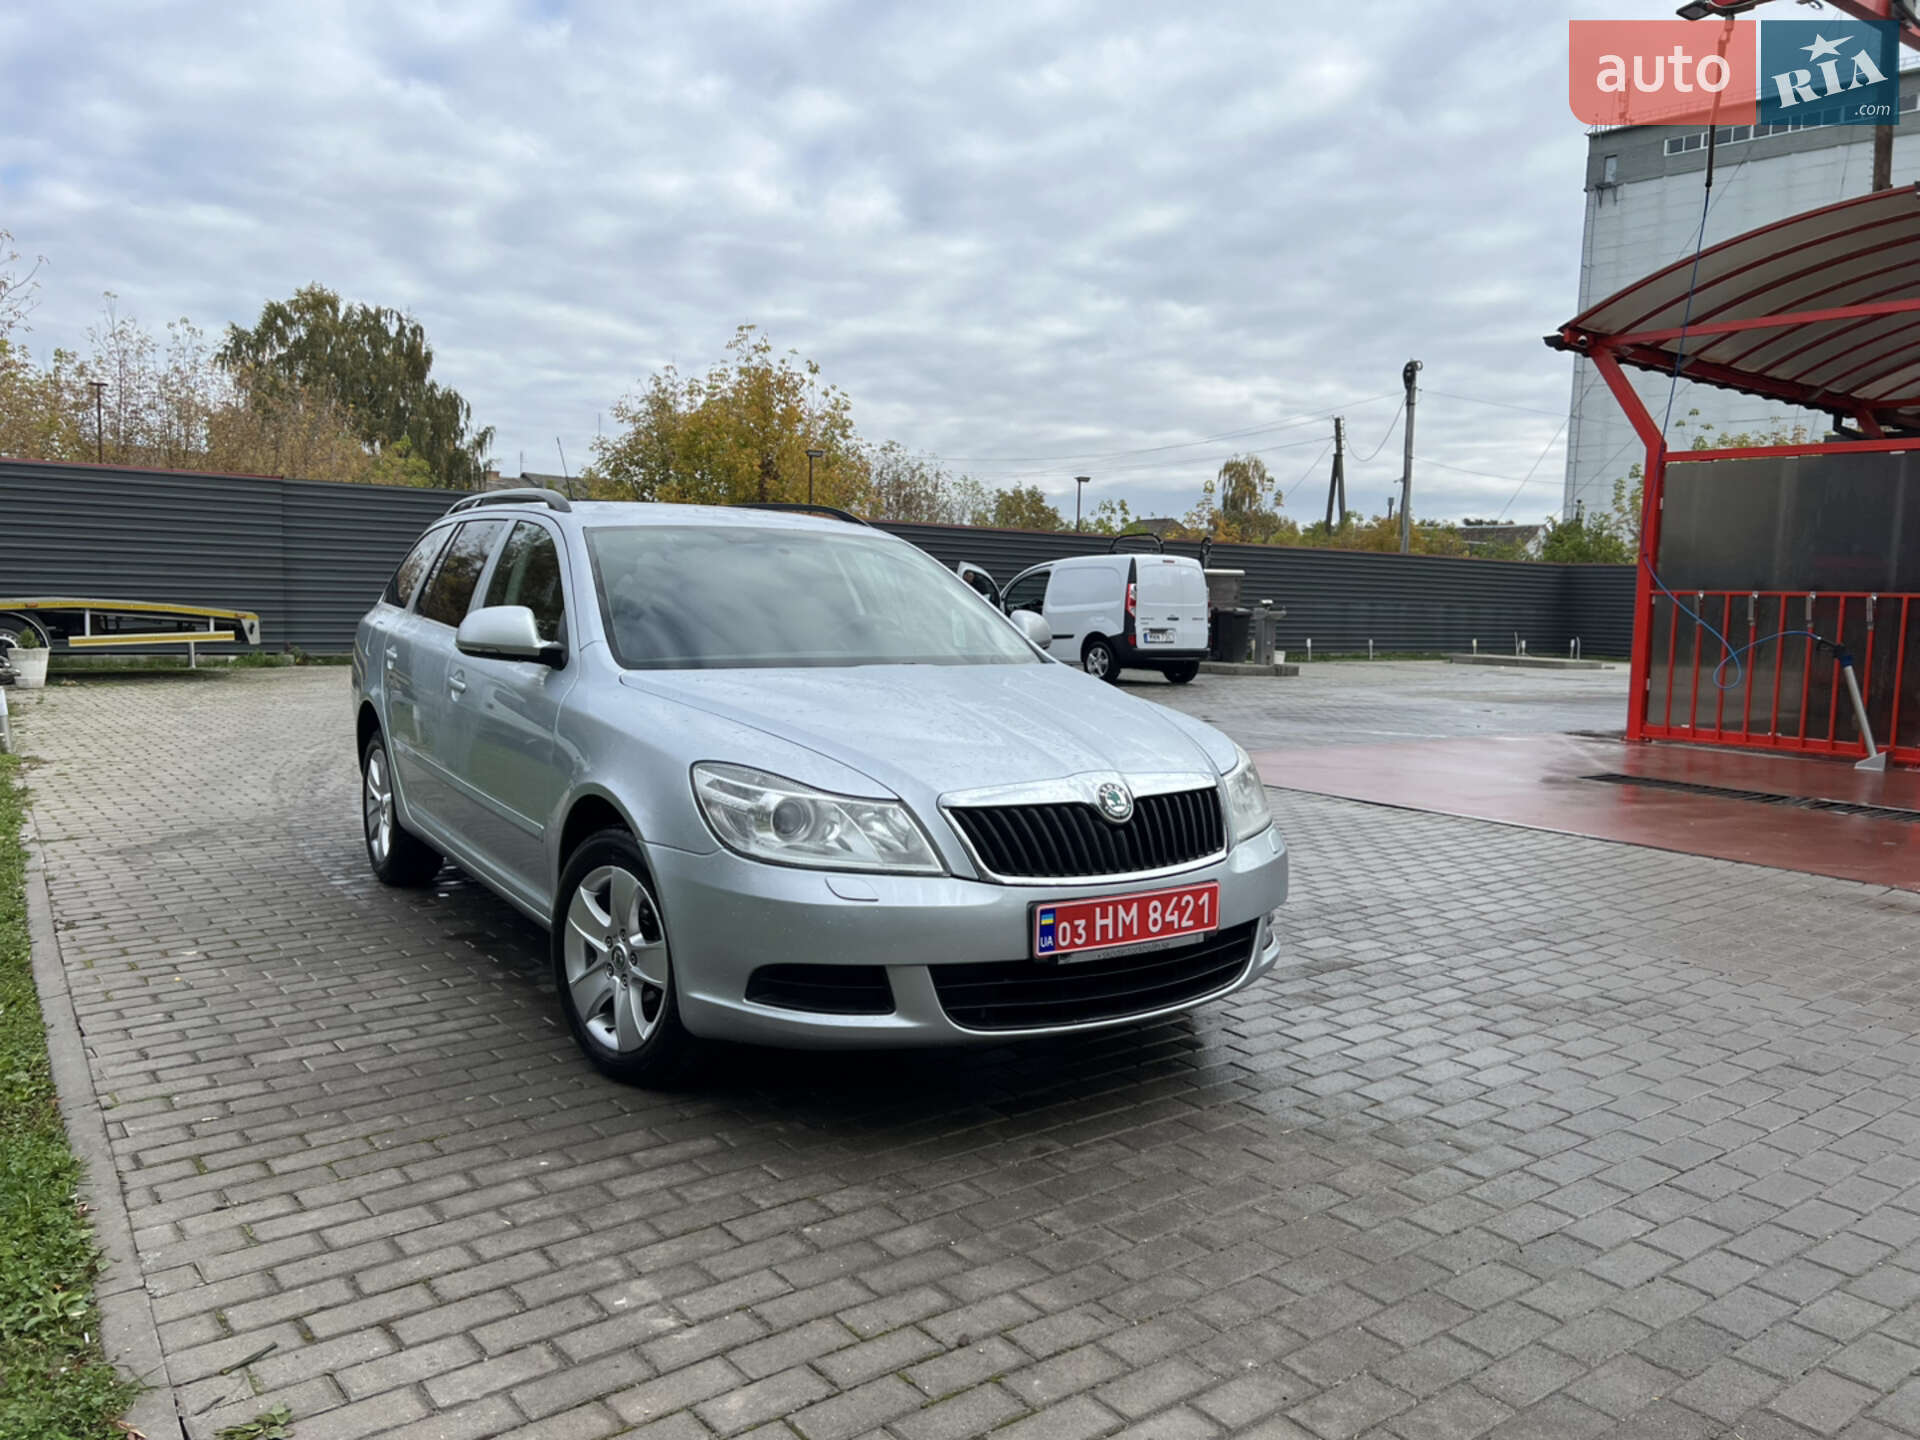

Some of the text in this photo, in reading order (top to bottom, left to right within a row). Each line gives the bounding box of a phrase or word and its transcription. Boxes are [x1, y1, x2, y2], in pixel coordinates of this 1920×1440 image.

[1057, 892, 1210, 947] 03 HM 8421
[1040, 936, 1054, 948] UA
